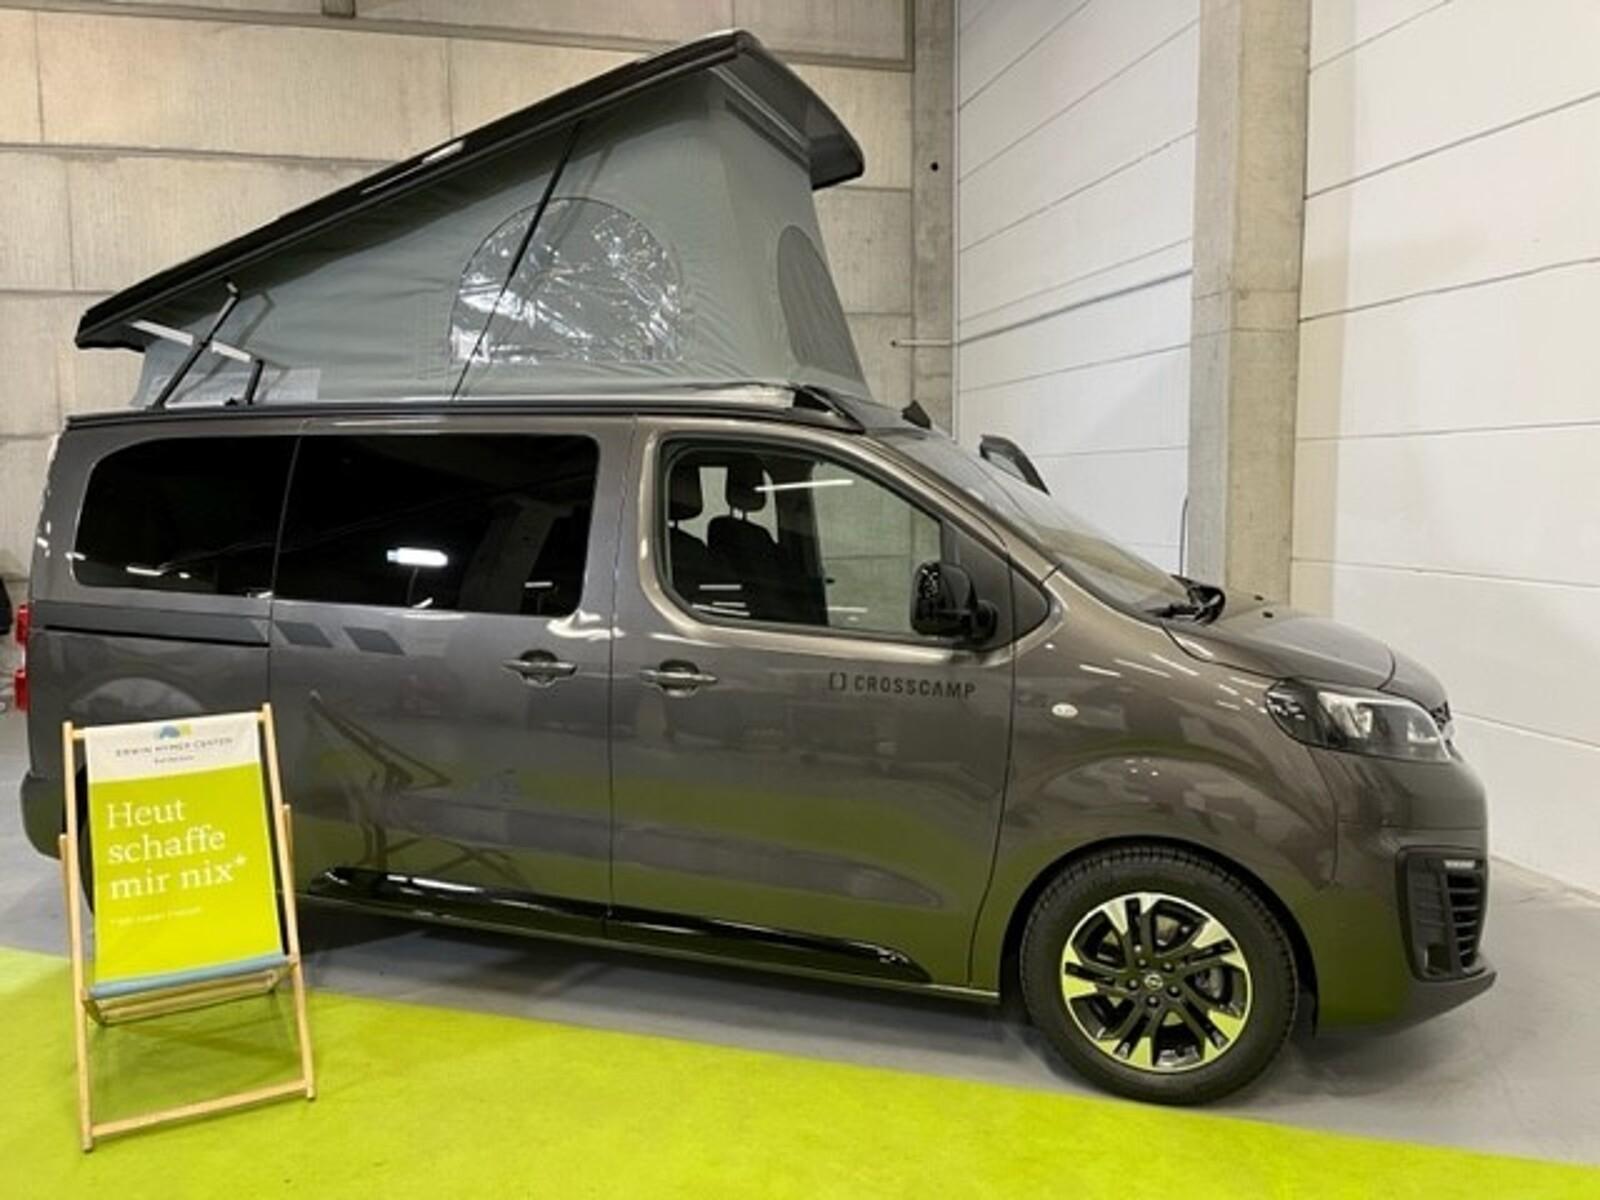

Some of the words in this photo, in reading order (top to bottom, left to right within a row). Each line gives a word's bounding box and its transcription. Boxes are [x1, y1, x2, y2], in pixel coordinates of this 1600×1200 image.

[854, 674, 976, 699] CROSSCAMP
[107, 800, 186, 829] Heut
[108, 824, 226, 864] schaffe
[110, 868, 171, 900] mir
